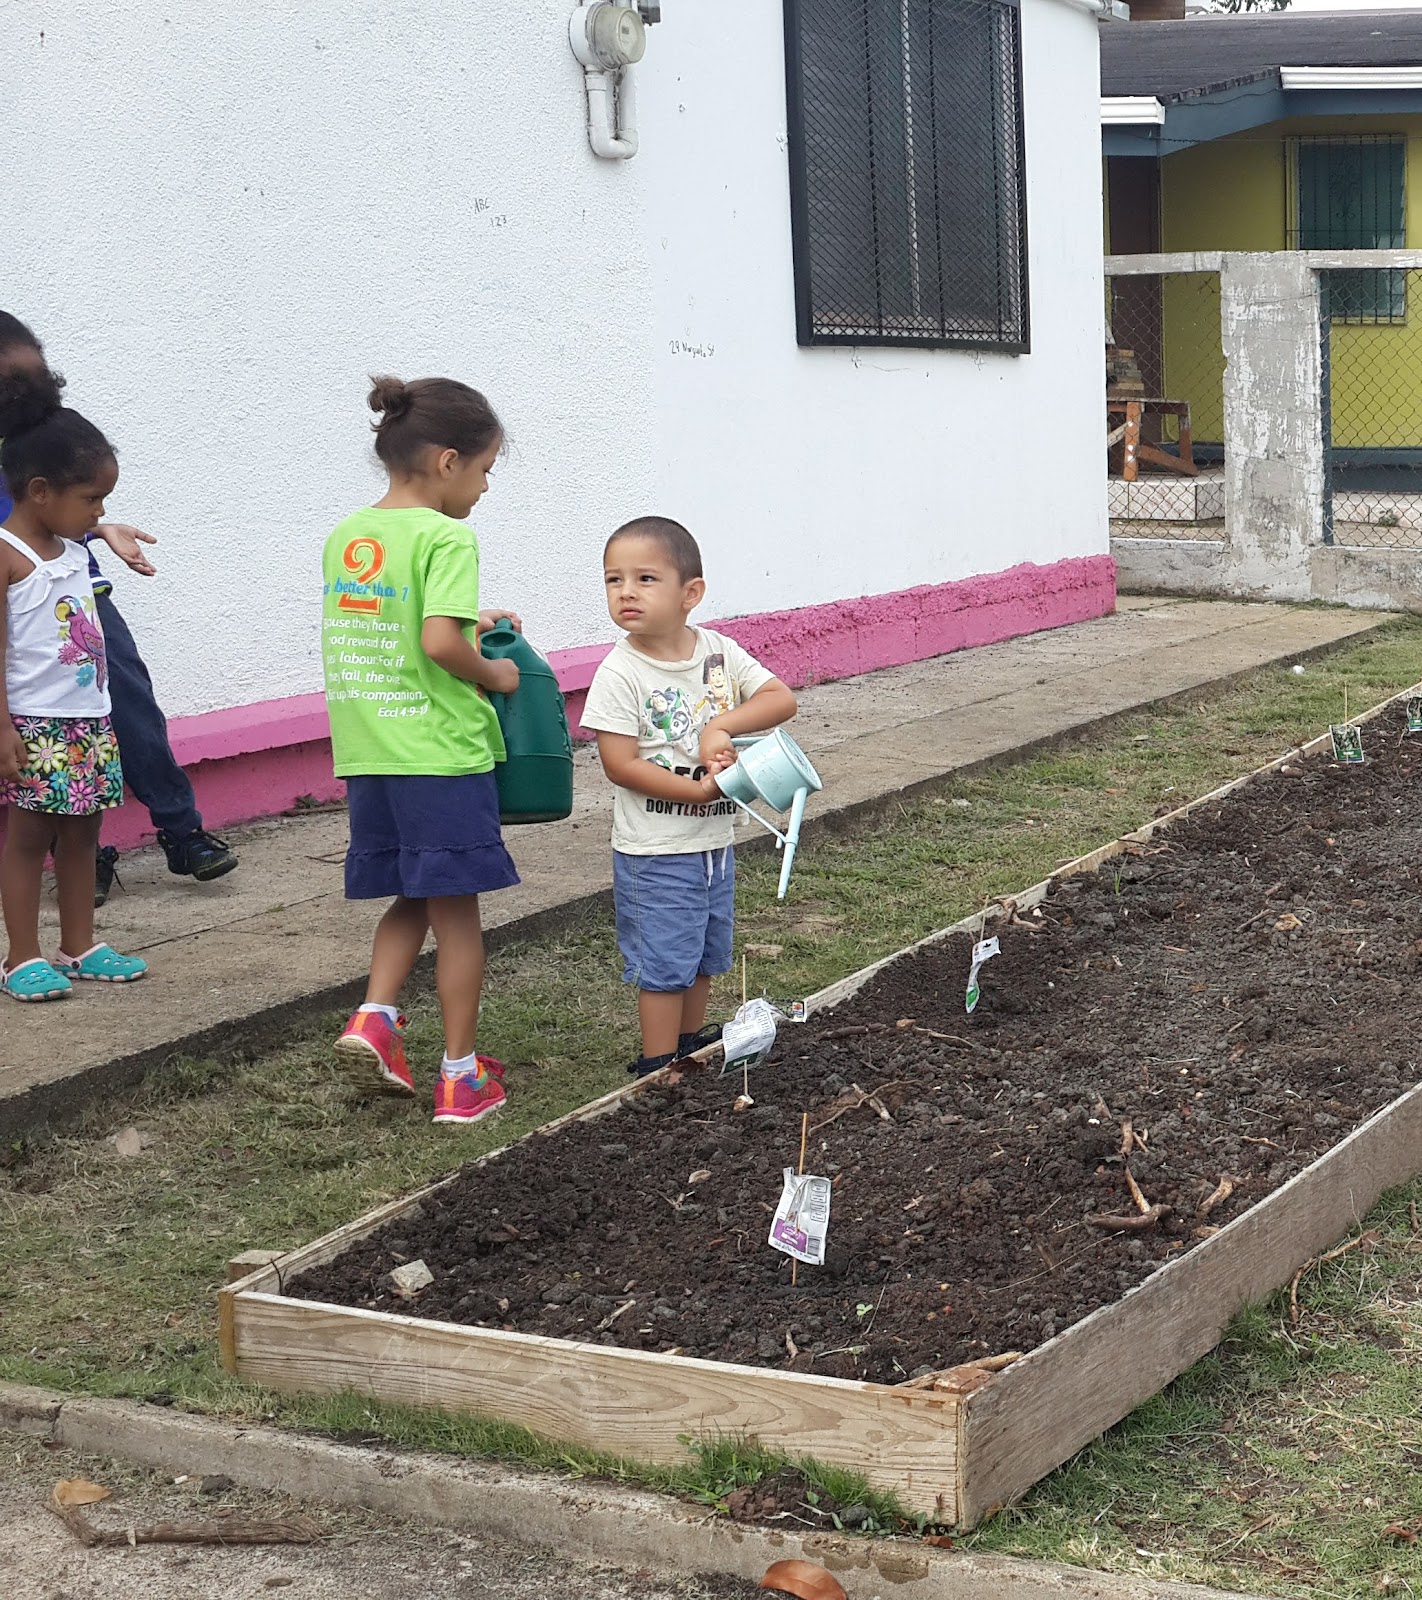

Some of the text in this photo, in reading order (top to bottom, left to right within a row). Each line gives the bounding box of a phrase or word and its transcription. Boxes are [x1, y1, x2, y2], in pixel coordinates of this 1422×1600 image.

[490, 214, 507, 228] 123
[338, 537, 386, 615] 2
[335, 577, 370, 594] better
[352, 617, 371, 632] they
[372, 619, 399, 632] have
[380, 637, 399, 649] for
[395, 655, 405, 668] if
[366, 671, 385, 683] the
[378, 706, 399, 717] Eccl
[646, 799, 684, 815] DON'T
